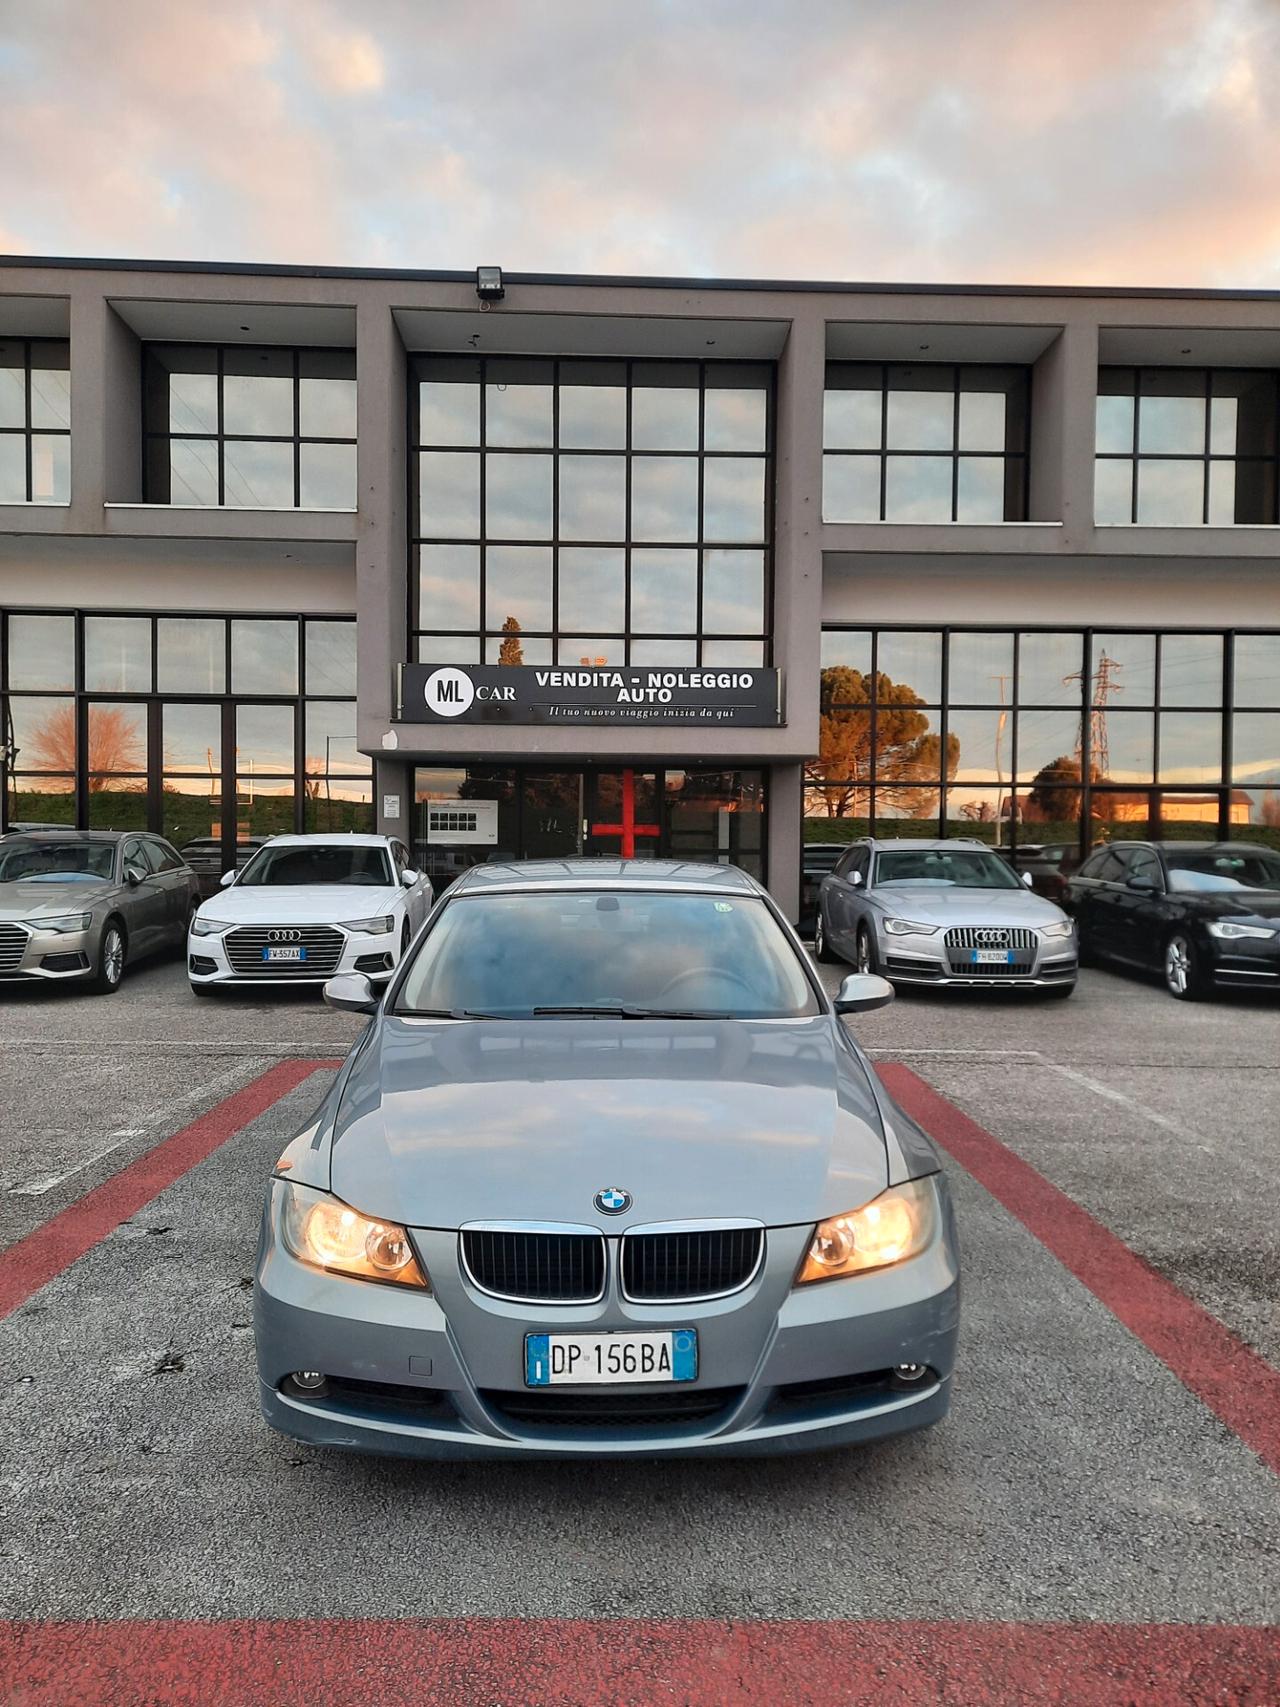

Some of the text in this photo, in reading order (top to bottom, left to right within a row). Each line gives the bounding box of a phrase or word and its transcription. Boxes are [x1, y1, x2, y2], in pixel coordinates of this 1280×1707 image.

[535, 672, 625, 687] VENDITA
[648, 673, 754, 688] NOLEGGIO
[436, 680, 517, 703] ML CAR
[616, 688, 673, 703] AUTO
[549, 706, 559, 716] Il
[562, 708, 580, 716] tuo
[620, 707, 659, 719] viaggio
[663, 707, 696, 717] inizia
[699, 707, 713, 717] da
[716, 707, 734, 719] qui
[551, 1344, 582, 1375] DP
[594, 1343, 671, 1375] 156BA
